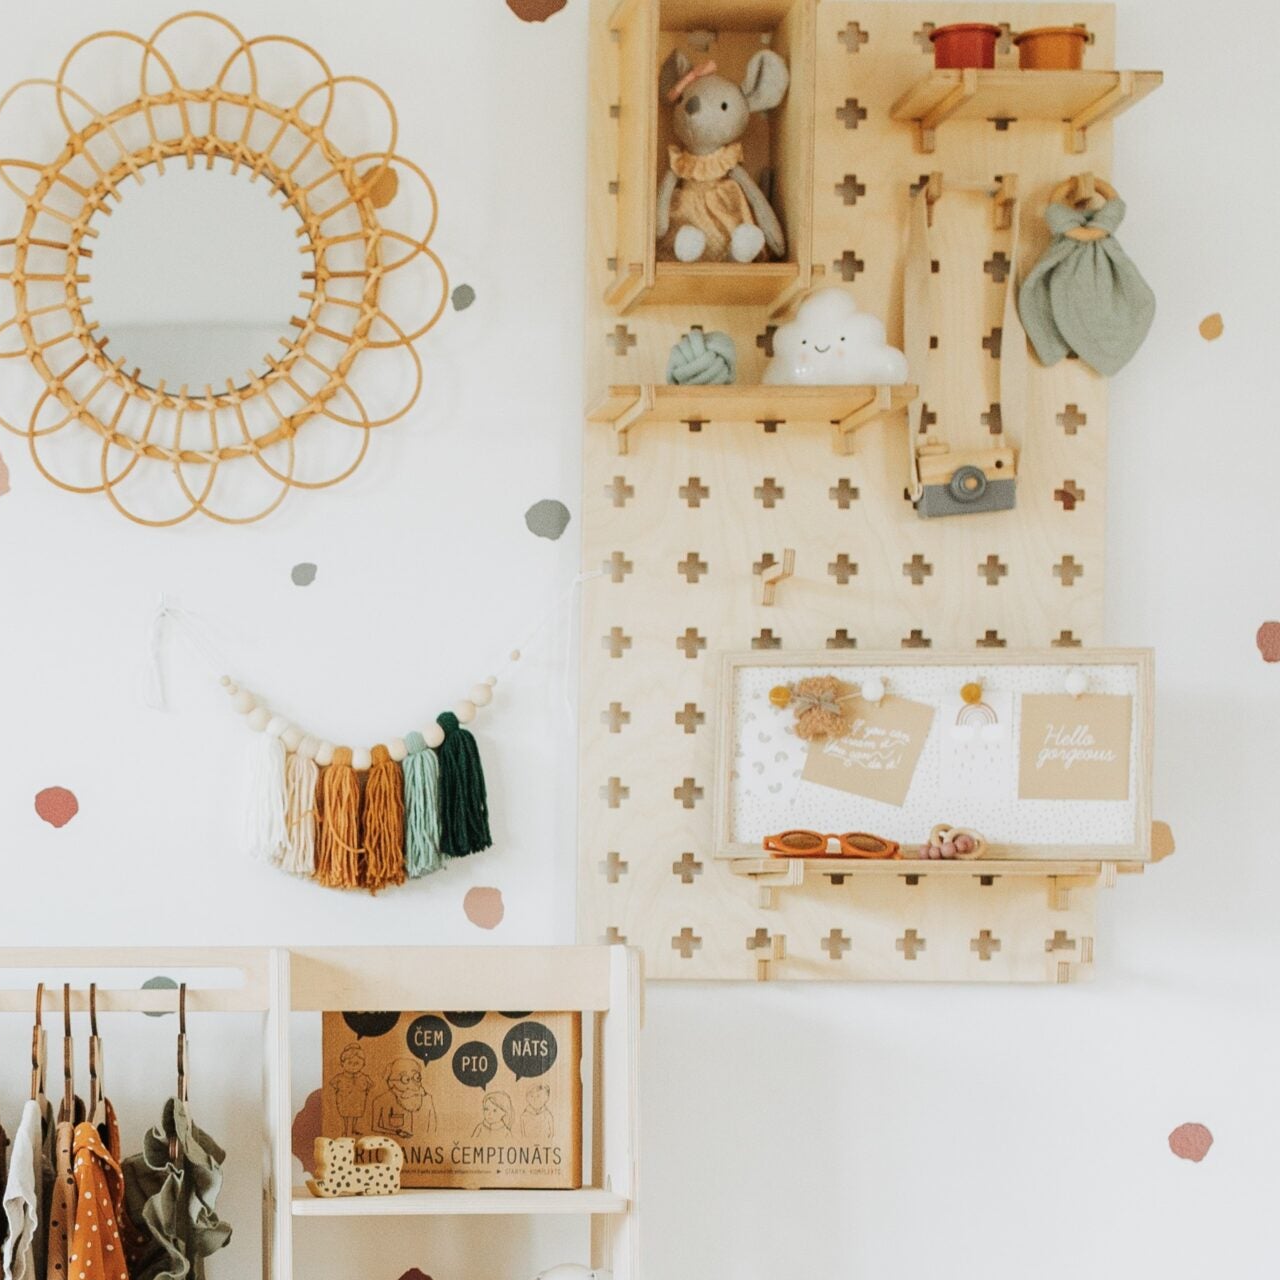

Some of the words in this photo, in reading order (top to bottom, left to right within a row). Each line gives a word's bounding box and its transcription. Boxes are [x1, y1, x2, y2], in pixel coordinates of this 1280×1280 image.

[1043, 721, 1097, 746] Hello
[1035, 747, 1118, 770] gorgeous
[413, 1026, 445, 1047] ČEM
[511, 1038, 549, 1058] NĀTS
[461, 1055, 489, 1073] PIO
[450, 1141, 562, 1166] ČEMPIONĀTS
